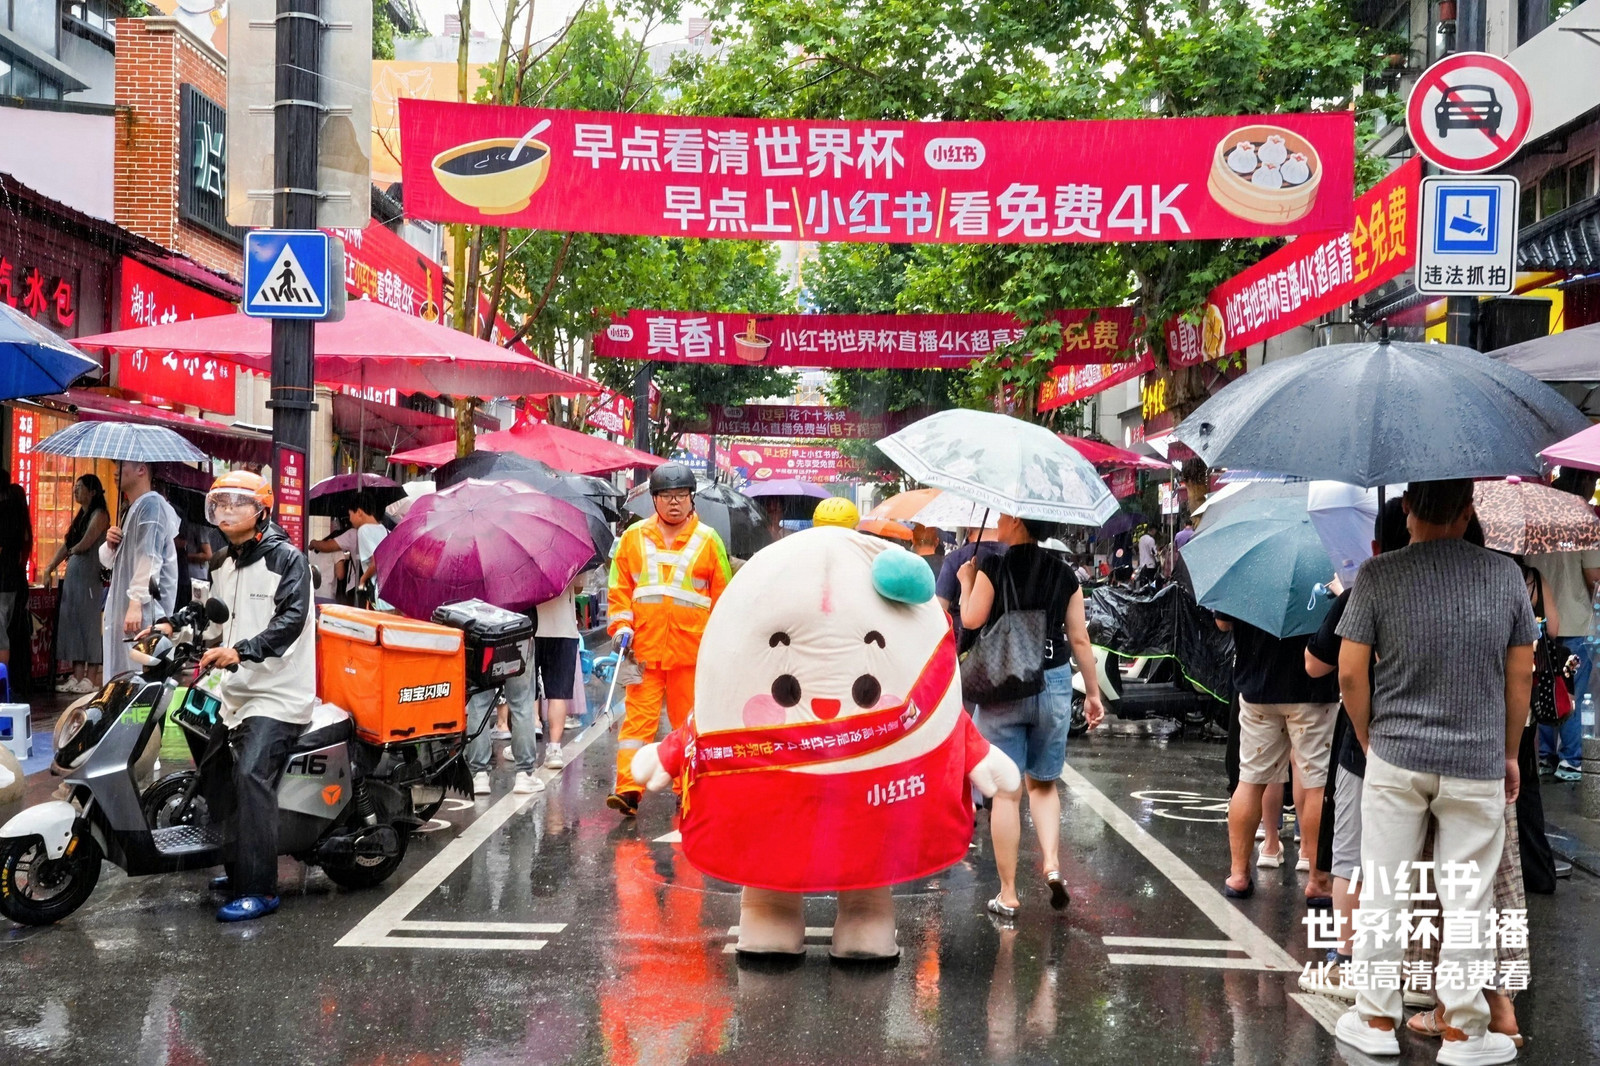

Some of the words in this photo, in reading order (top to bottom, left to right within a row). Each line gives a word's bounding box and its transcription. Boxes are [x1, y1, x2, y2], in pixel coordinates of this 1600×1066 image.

[572, 124, 905, 181] 早点看清世界杯
[931, 144, 979, 165] 小红书
[1424, 264, 1507, 288] 违法抓拍
[646, 316, 727, 358] 真香!
[399, 682, 451, 704] 淘宝闪购
[866, 774, 926, 807] 小红书
